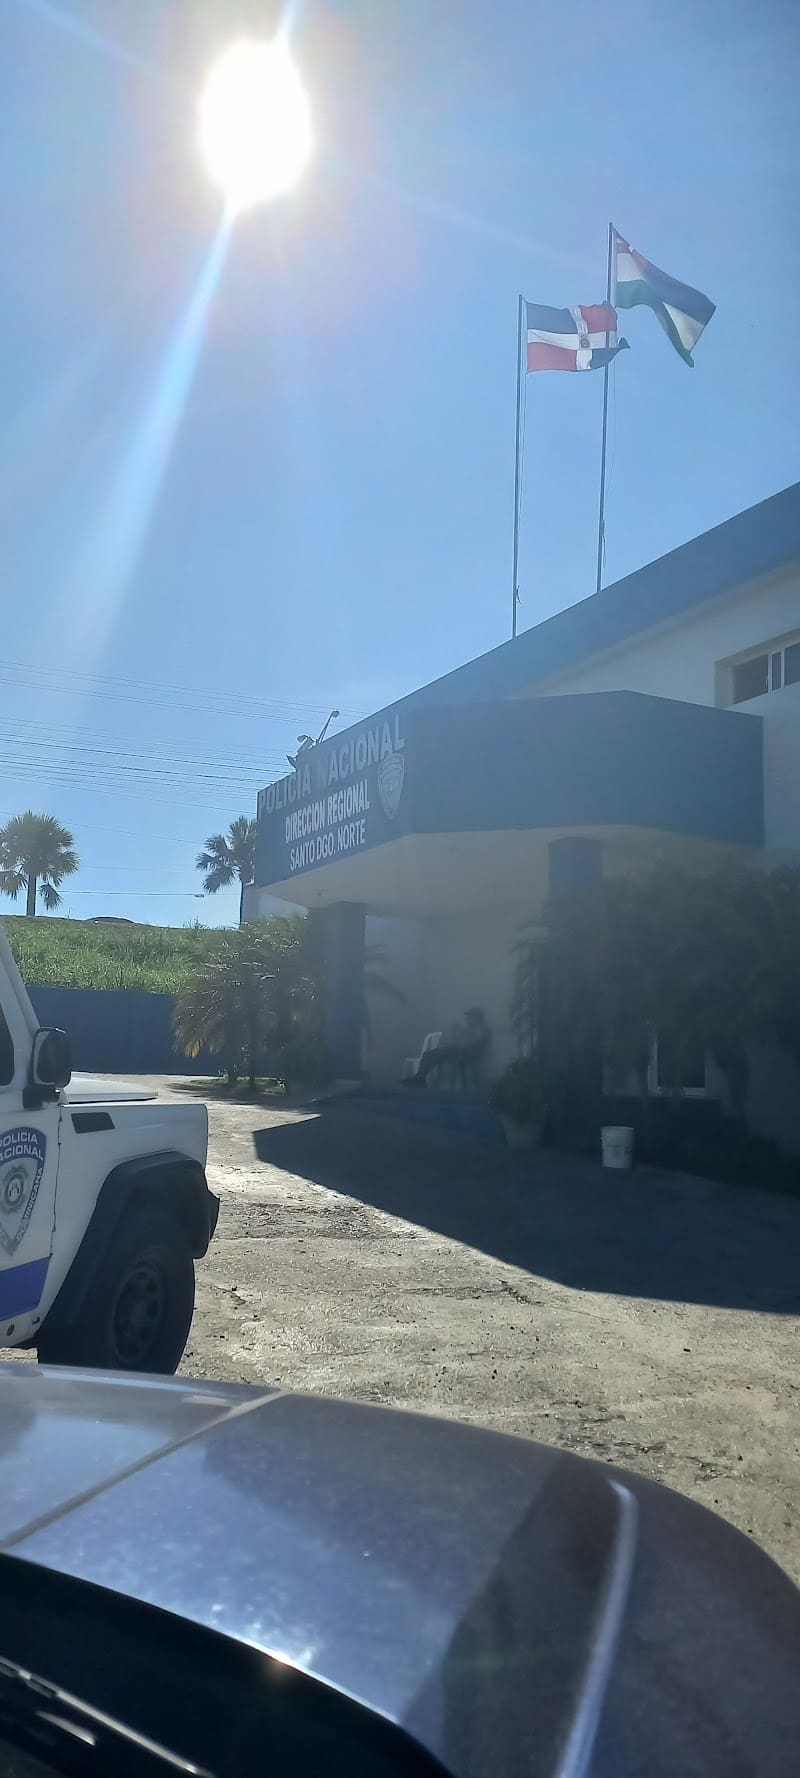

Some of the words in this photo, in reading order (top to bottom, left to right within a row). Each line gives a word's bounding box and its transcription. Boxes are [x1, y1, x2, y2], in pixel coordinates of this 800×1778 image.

[259, 763, 312, 820] POLICIA
[316, 713, 405, 789] NACIONAL
[285, 800, 326, 844] DIRECCION
[327, 779, 370, 825] REGIONAL
[290, 841, 315, 871] SANTO
[316, 834, 335, 861] DGO.
[337, 818, 366, 851] NORTE
[0, 1144, 44, 1161] ACIONAL
[16, 1167, 43, 1241] DOINICANA
